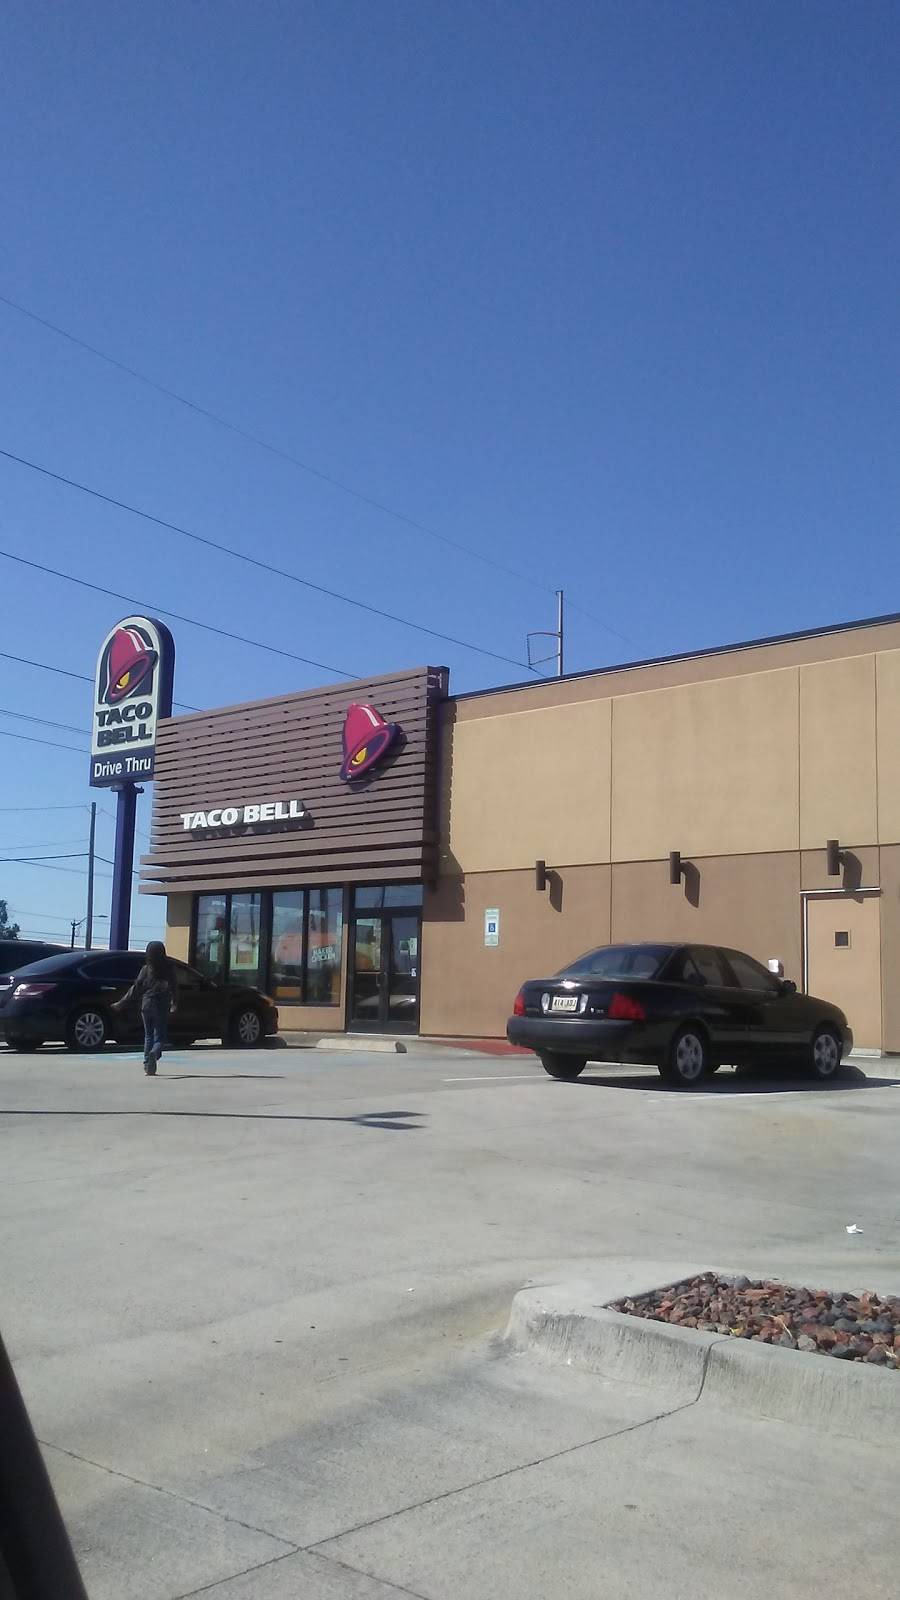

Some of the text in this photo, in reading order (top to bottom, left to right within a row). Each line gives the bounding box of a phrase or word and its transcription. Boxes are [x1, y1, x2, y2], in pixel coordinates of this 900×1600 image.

[95, 702, 153, 727] TACO
[97, 723, 153, 748] BELL
[94, 756, 152, 778] Drive Thru
[180, 799, 305, 830] TACO BELL
